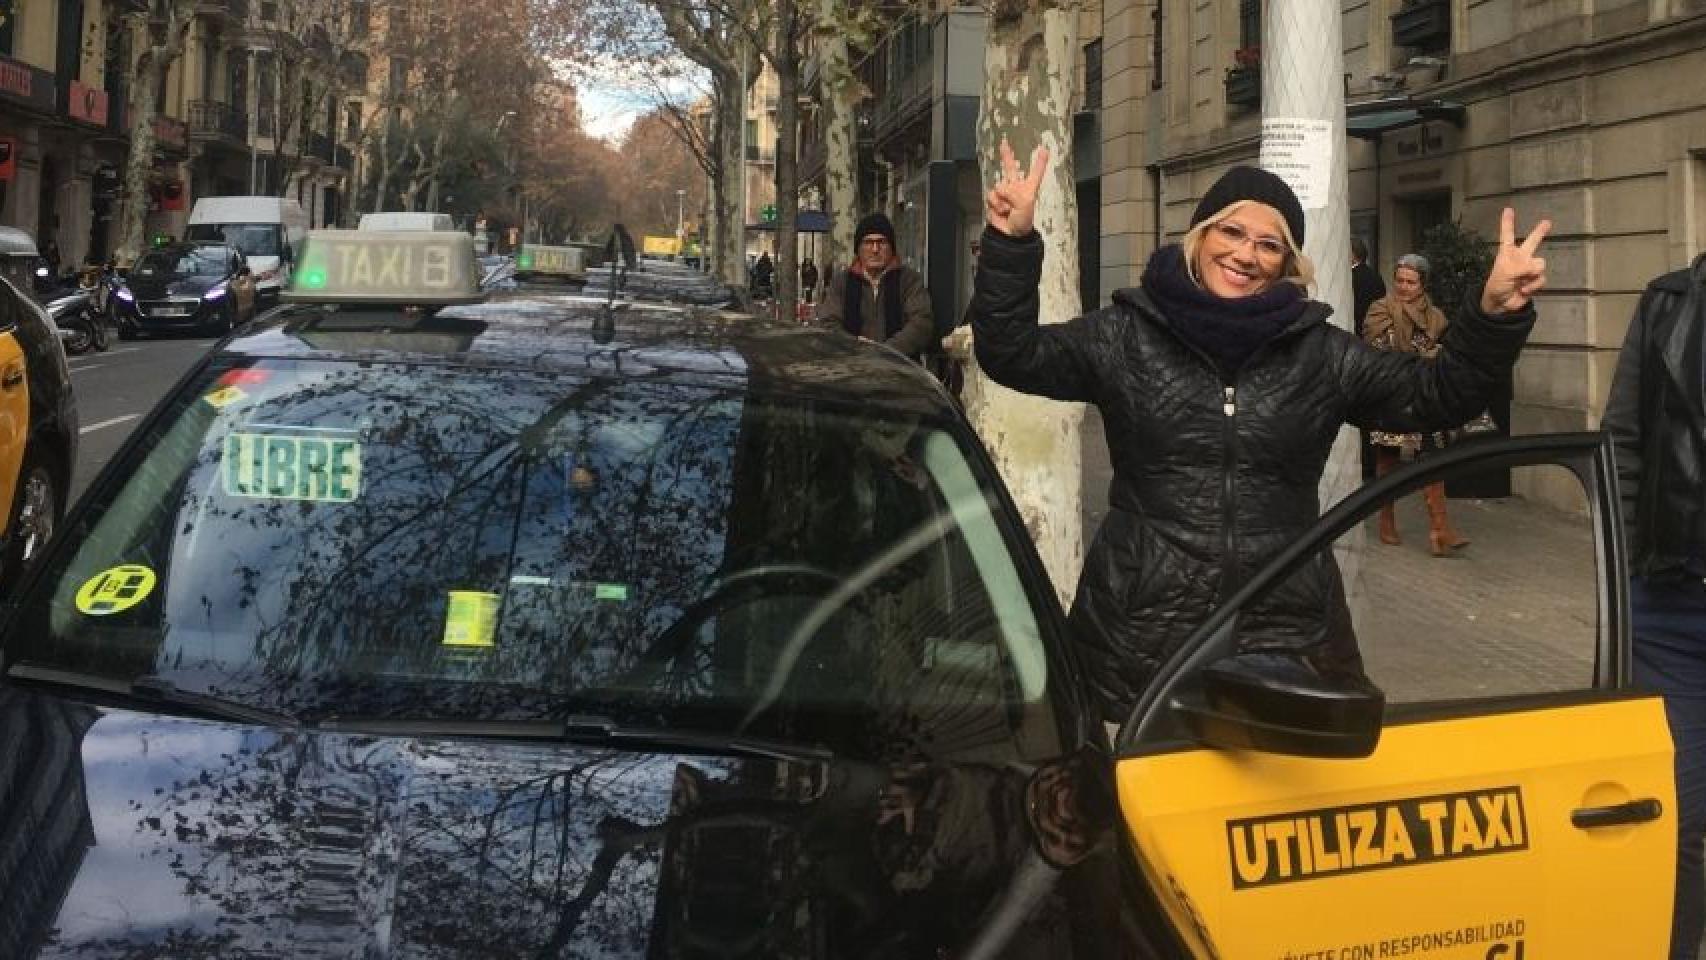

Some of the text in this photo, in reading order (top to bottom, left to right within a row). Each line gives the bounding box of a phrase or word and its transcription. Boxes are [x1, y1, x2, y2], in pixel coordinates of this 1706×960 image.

[335, 245, 412, 286] TAXI
[229, 436, 354, 499] LIBRE
[1232, 793, 1524, 883] UTILIZA TAXI
[1341, 944, 1374, 960] CON
[1380, 919, 1525, 959] RESPONSABILIDAD
